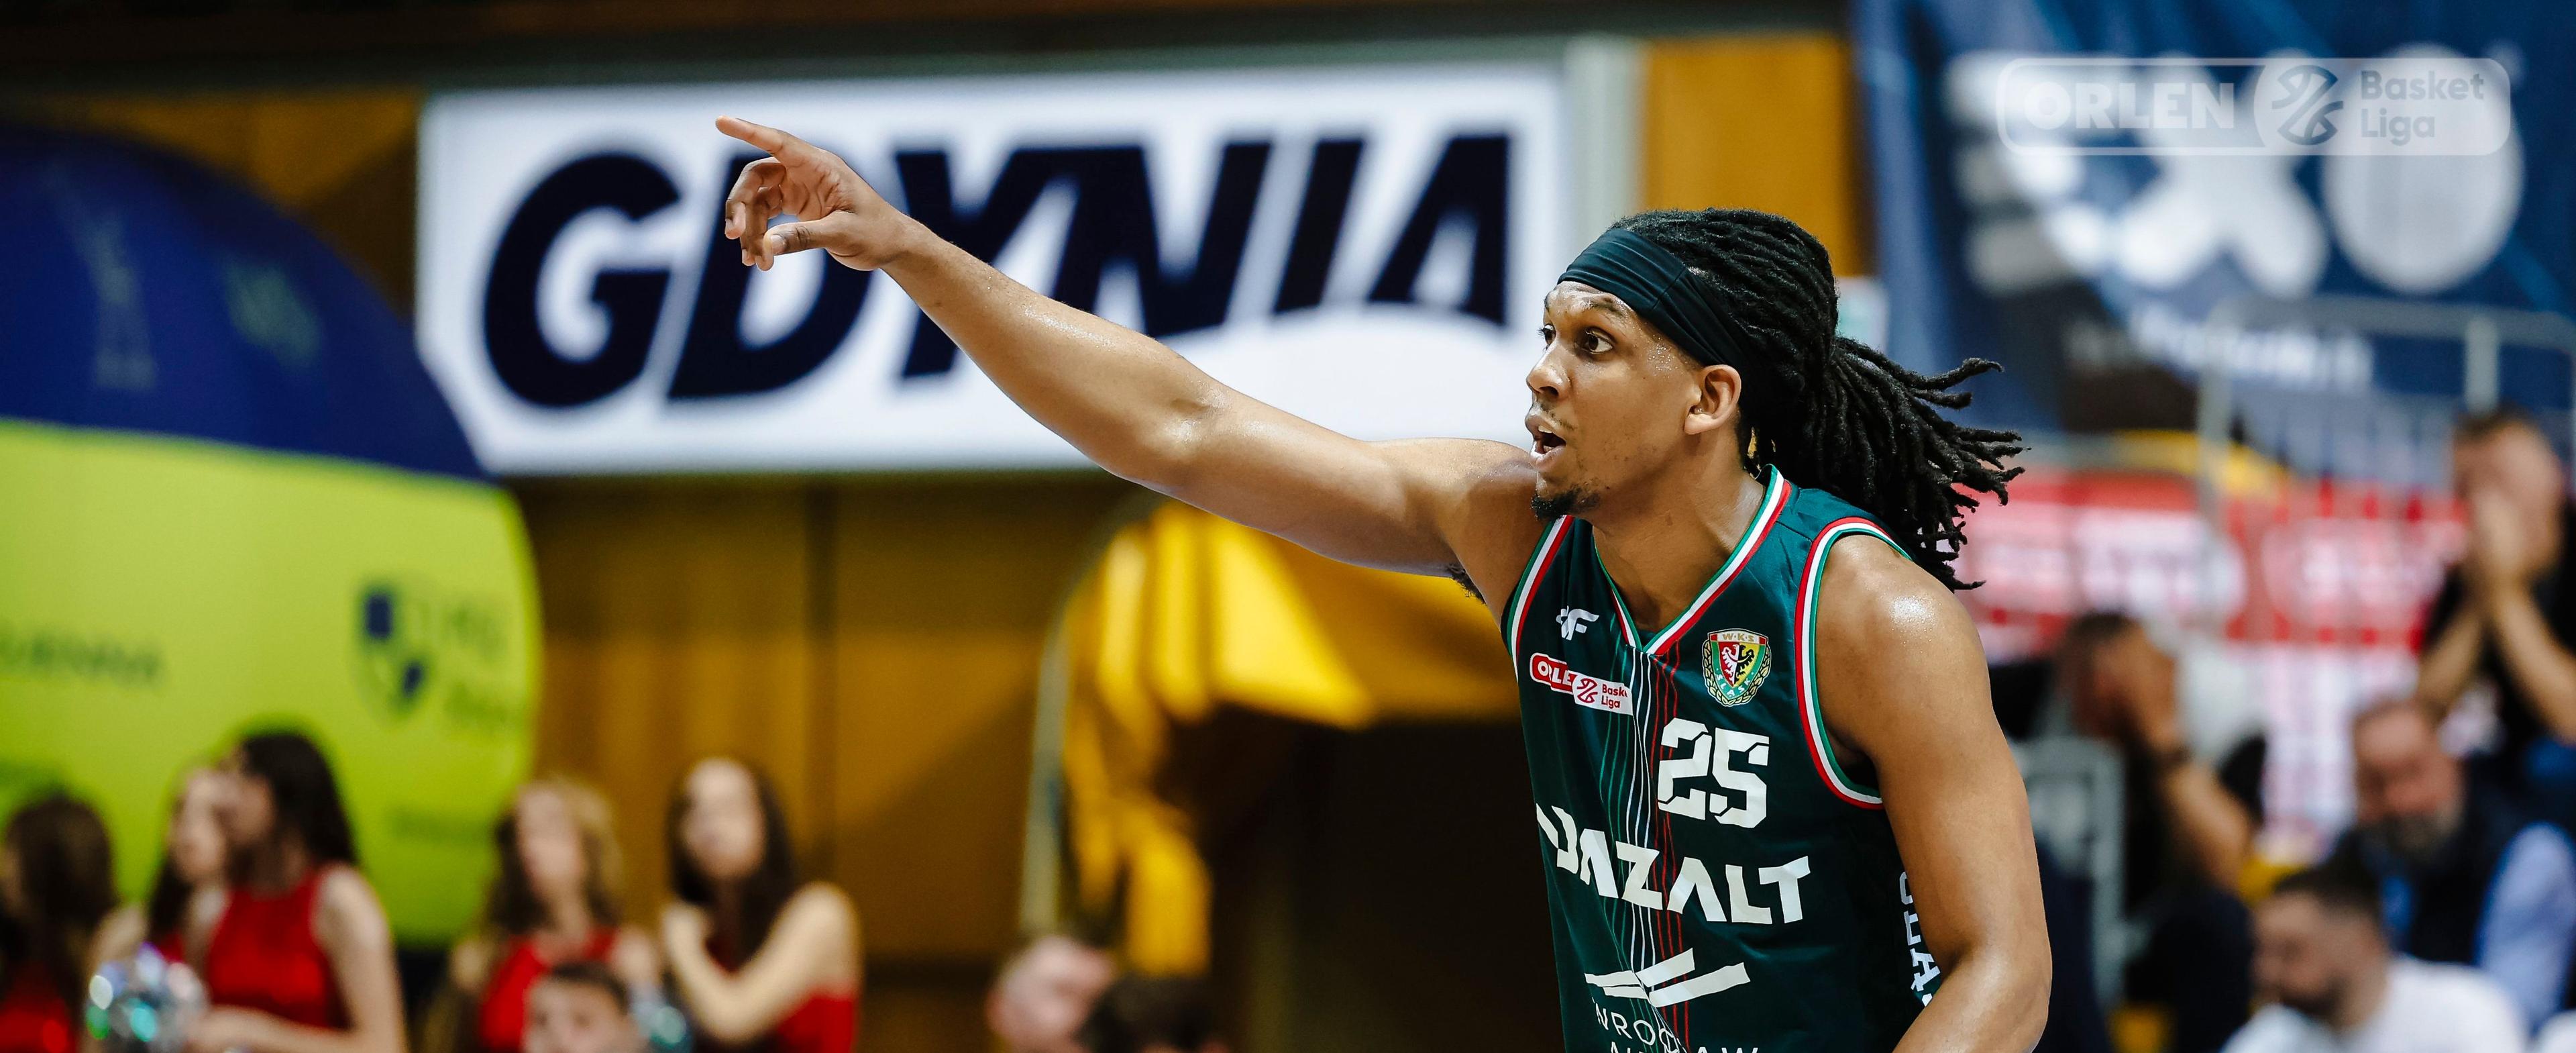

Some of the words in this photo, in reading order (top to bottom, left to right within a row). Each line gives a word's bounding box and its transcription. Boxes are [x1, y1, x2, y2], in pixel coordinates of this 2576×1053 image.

[482, 132, 1509, 407] GDYNIA
[1601, 695, 1620, 709] Liga
[1658, 717, 1769, 828] 25
